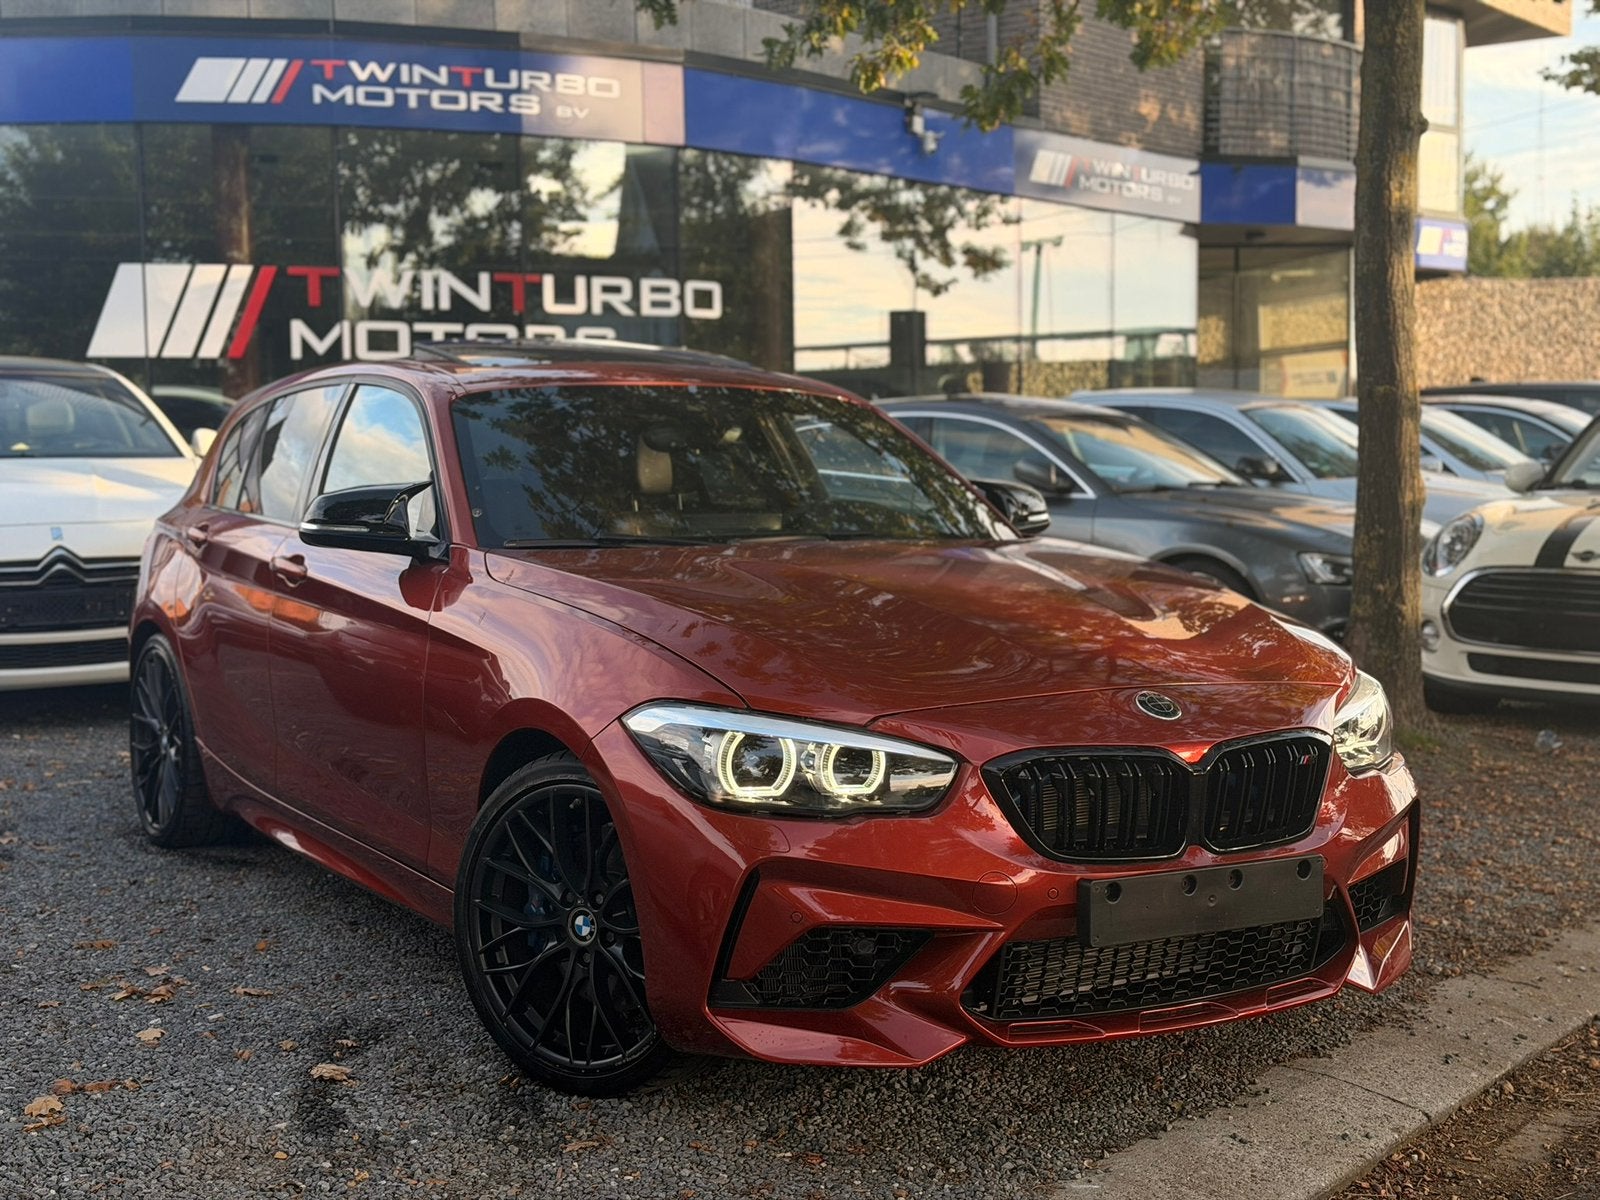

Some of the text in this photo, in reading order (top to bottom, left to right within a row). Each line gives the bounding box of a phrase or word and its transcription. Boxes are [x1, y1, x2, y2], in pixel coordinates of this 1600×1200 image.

[310, 59, 621, 99] TWINTURBO
[312, 83, 590, 119] MOTORS BV
[1079, 175, 1163, 203] MOTORS
[286, 265, 723, 320] TWINTURBO
